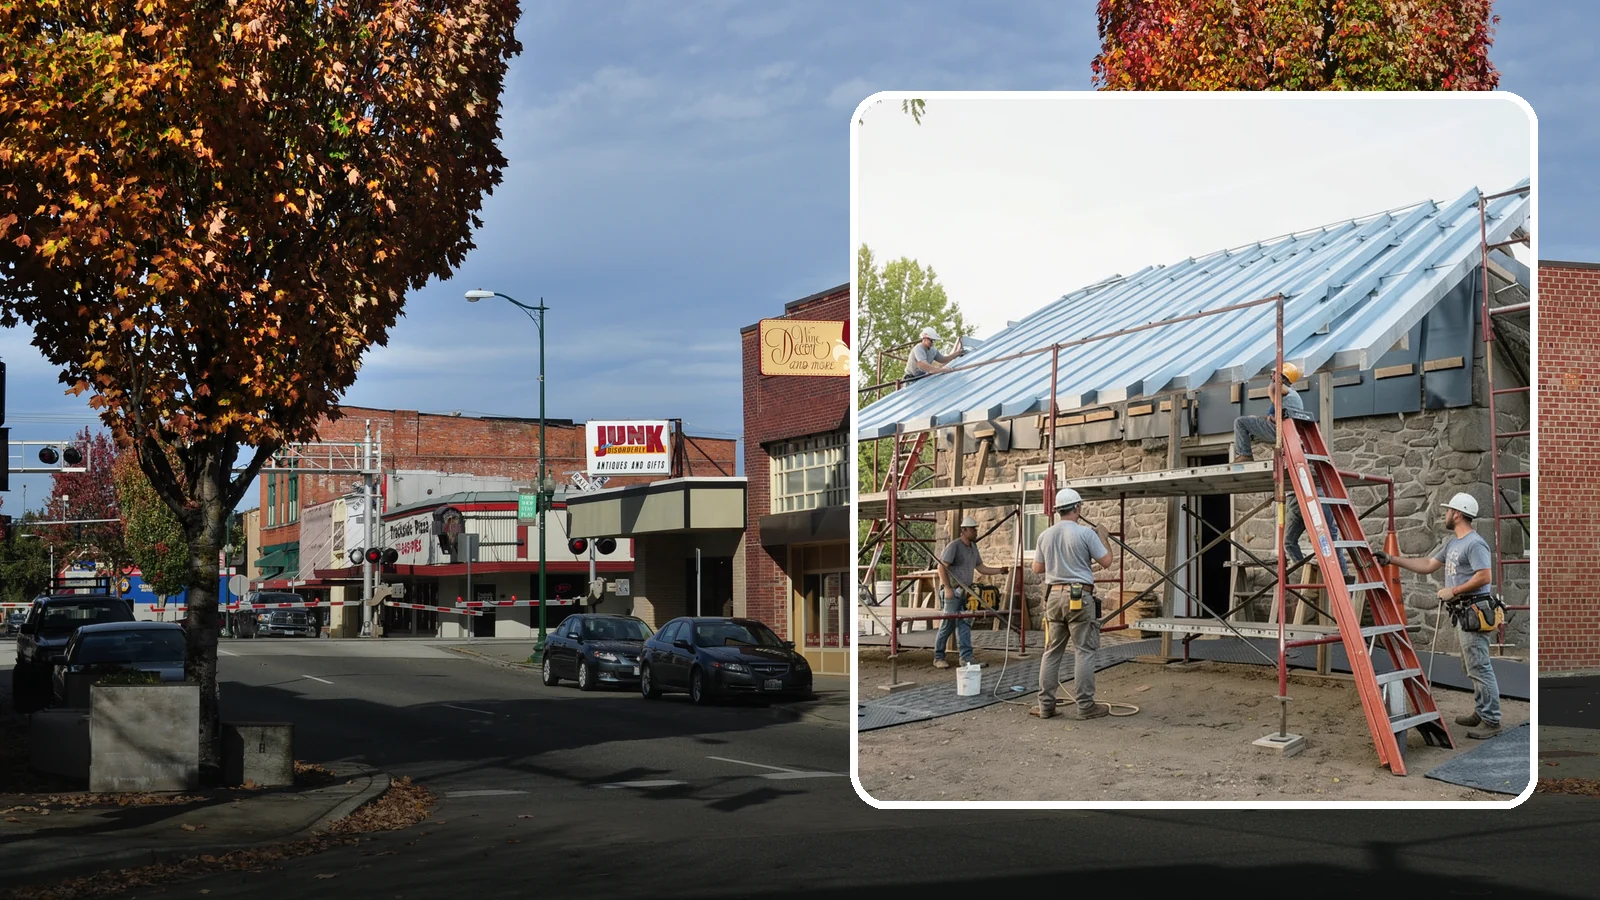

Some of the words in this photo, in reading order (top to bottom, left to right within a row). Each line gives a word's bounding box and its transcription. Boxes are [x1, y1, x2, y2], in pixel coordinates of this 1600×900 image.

[595, 425, 665, 457] JUNK
[607, 446, 646, 454] DISORDERLY
[597, 461, 628, 470] ANTIQUES
[631, 461, 644, 470] AND
[647, 461, 665, 470] GIFTS
[414, 519, 429, 535] Pizza
